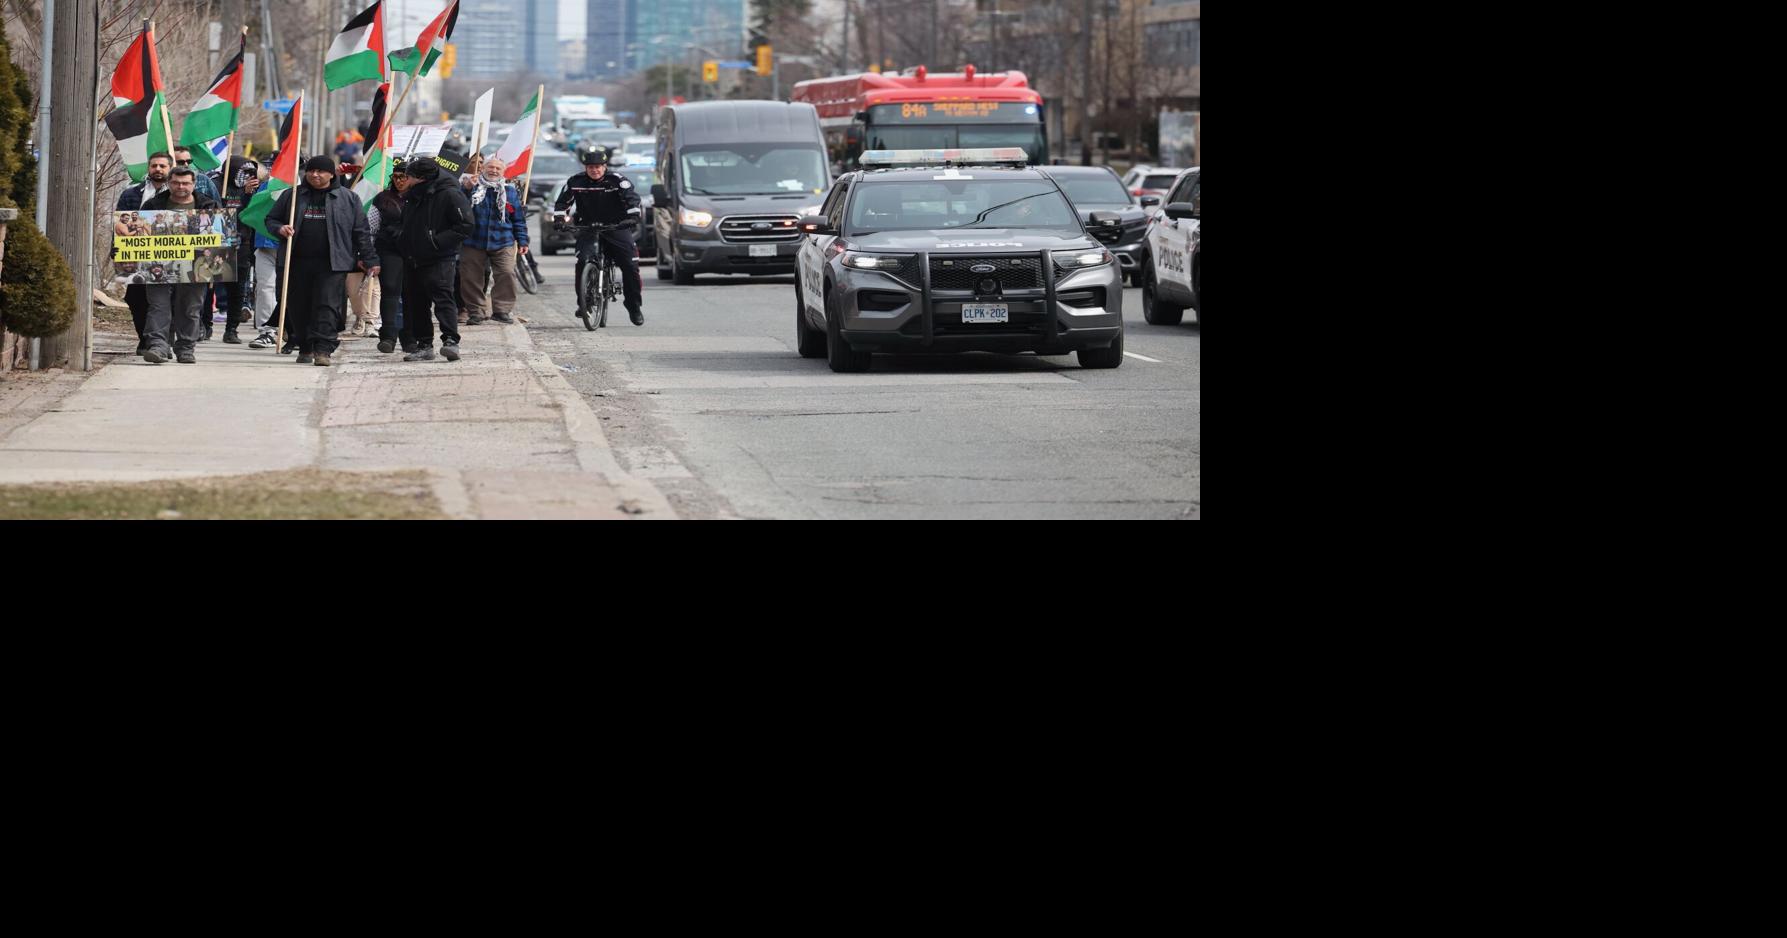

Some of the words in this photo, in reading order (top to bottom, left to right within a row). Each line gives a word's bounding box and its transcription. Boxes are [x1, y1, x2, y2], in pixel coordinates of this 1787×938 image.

[902, 103, 927, 118] 84A
[154, 237, 186, 246] MORAL
[190, 236, 216, 245] ARMY
[121, 251, 130, 259] IN
[134, 250, 150, 259] THE
[1158, 246, 1184, 273] POLICE
[963, 309, 985, 319] CLPK
[990, 309, 1007, 318] 202
